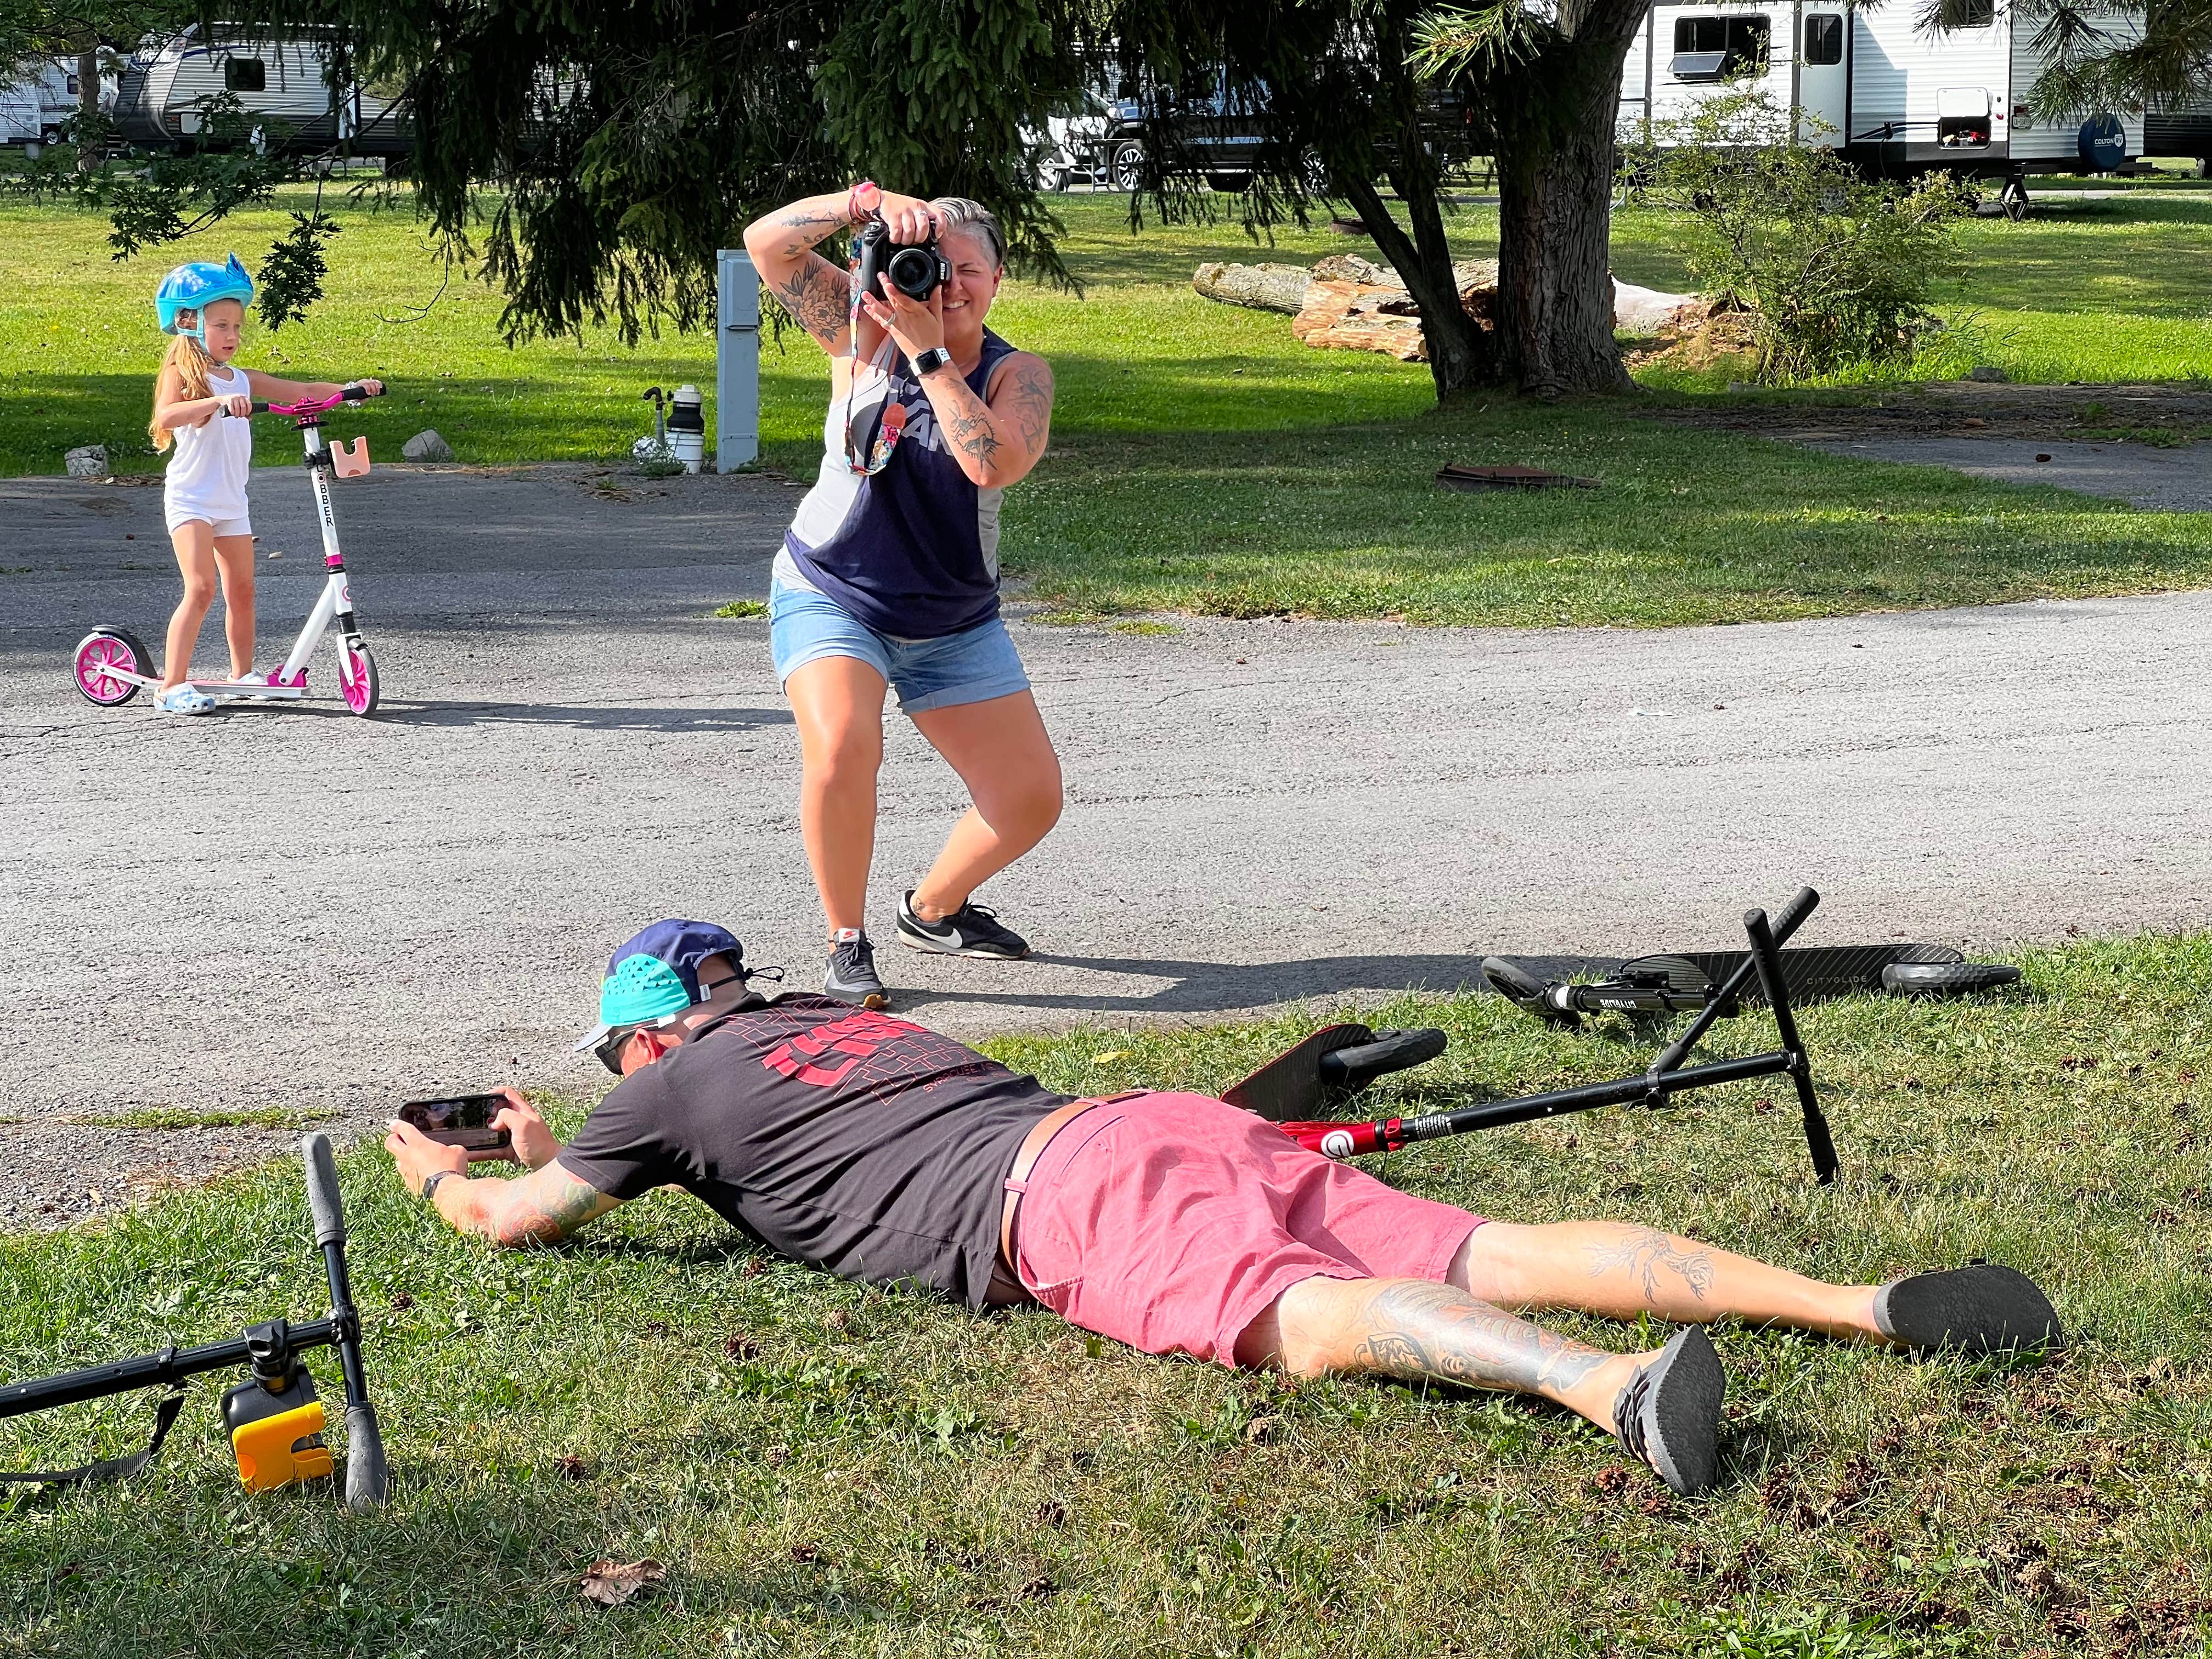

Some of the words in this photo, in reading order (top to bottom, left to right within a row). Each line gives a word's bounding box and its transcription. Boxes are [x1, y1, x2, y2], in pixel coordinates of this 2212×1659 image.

[317, 465, 334, 527] LOBBER
[1807, 975, 1867, 985] CITYGLIDE
[1599, 998, 1637, 1009] CITYGLIDE
